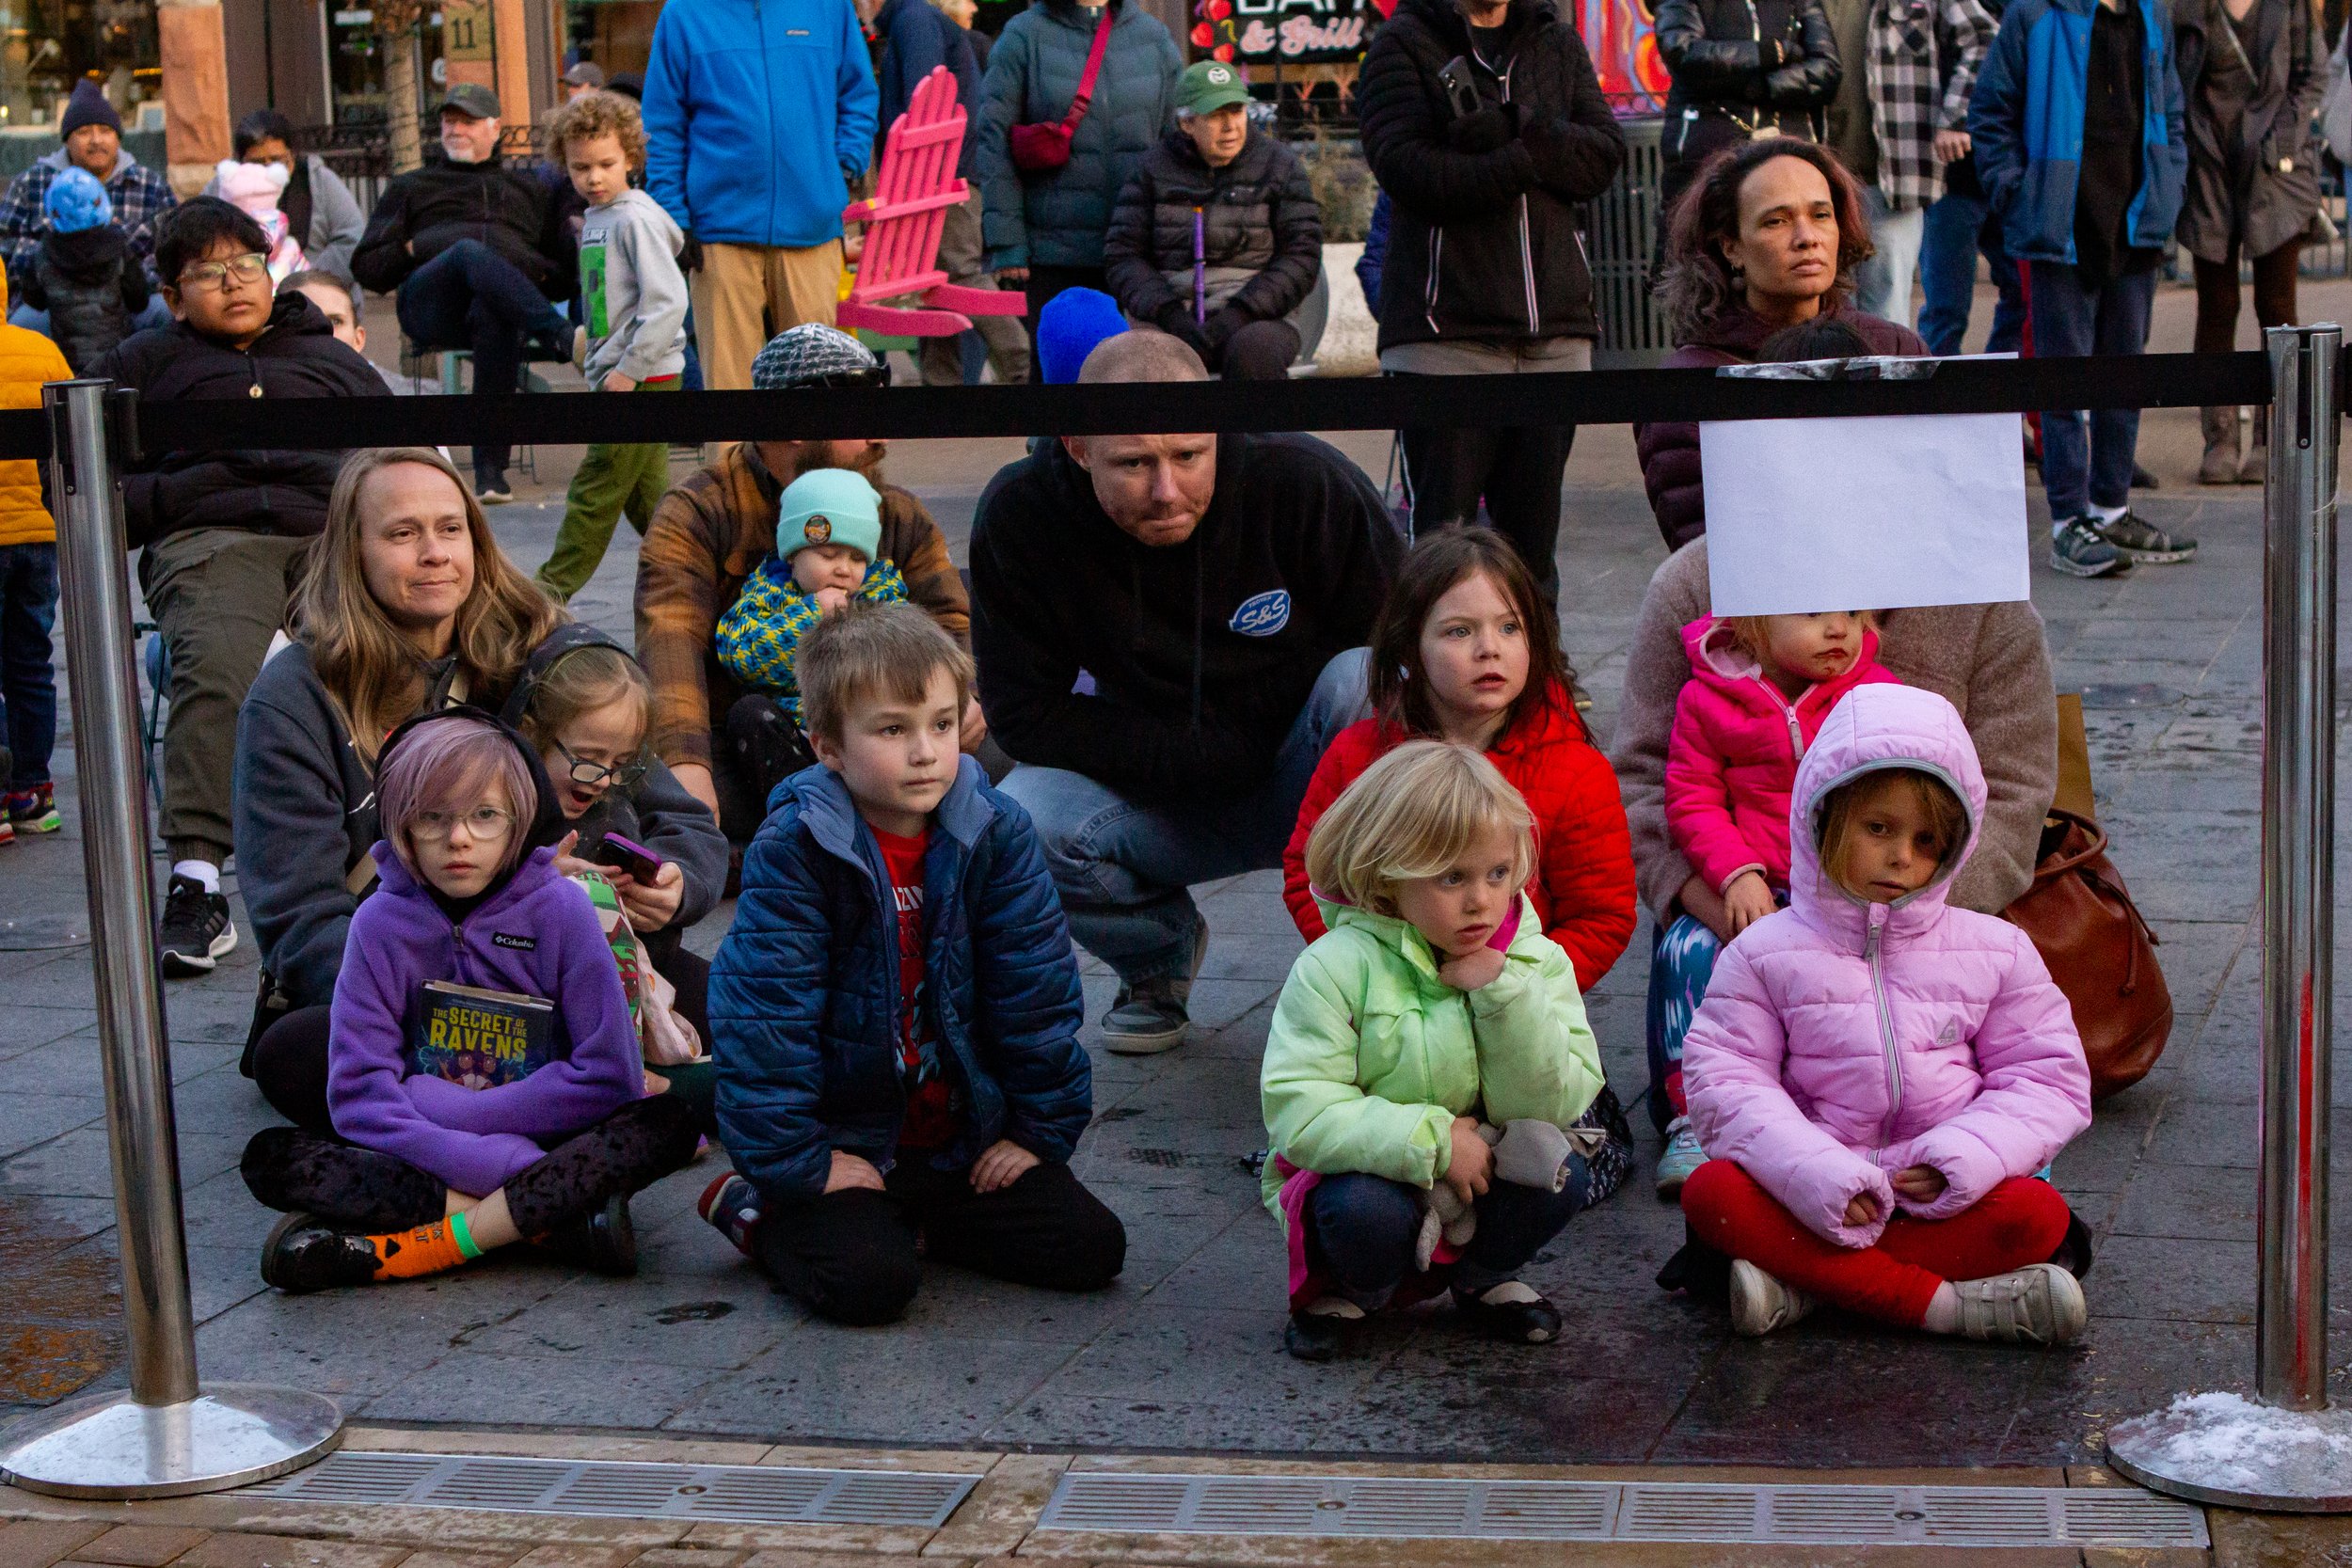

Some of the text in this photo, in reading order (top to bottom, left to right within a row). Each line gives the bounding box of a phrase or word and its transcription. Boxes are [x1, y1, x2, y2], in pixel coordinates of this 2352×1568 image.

[452, 18, 476, 49] 11
[1240, 14, 1365, 55] & Grill
[1240, 594, 1286, 630] S&S
[433, 1007, 449, 1019] THE
[449, 1006, 514, 1034] SECRET
[515, 1018, 527, 1028] OF
[513, 1027, 527, 1037] THE
[429, 1018, 527, 1063] RAVENS
